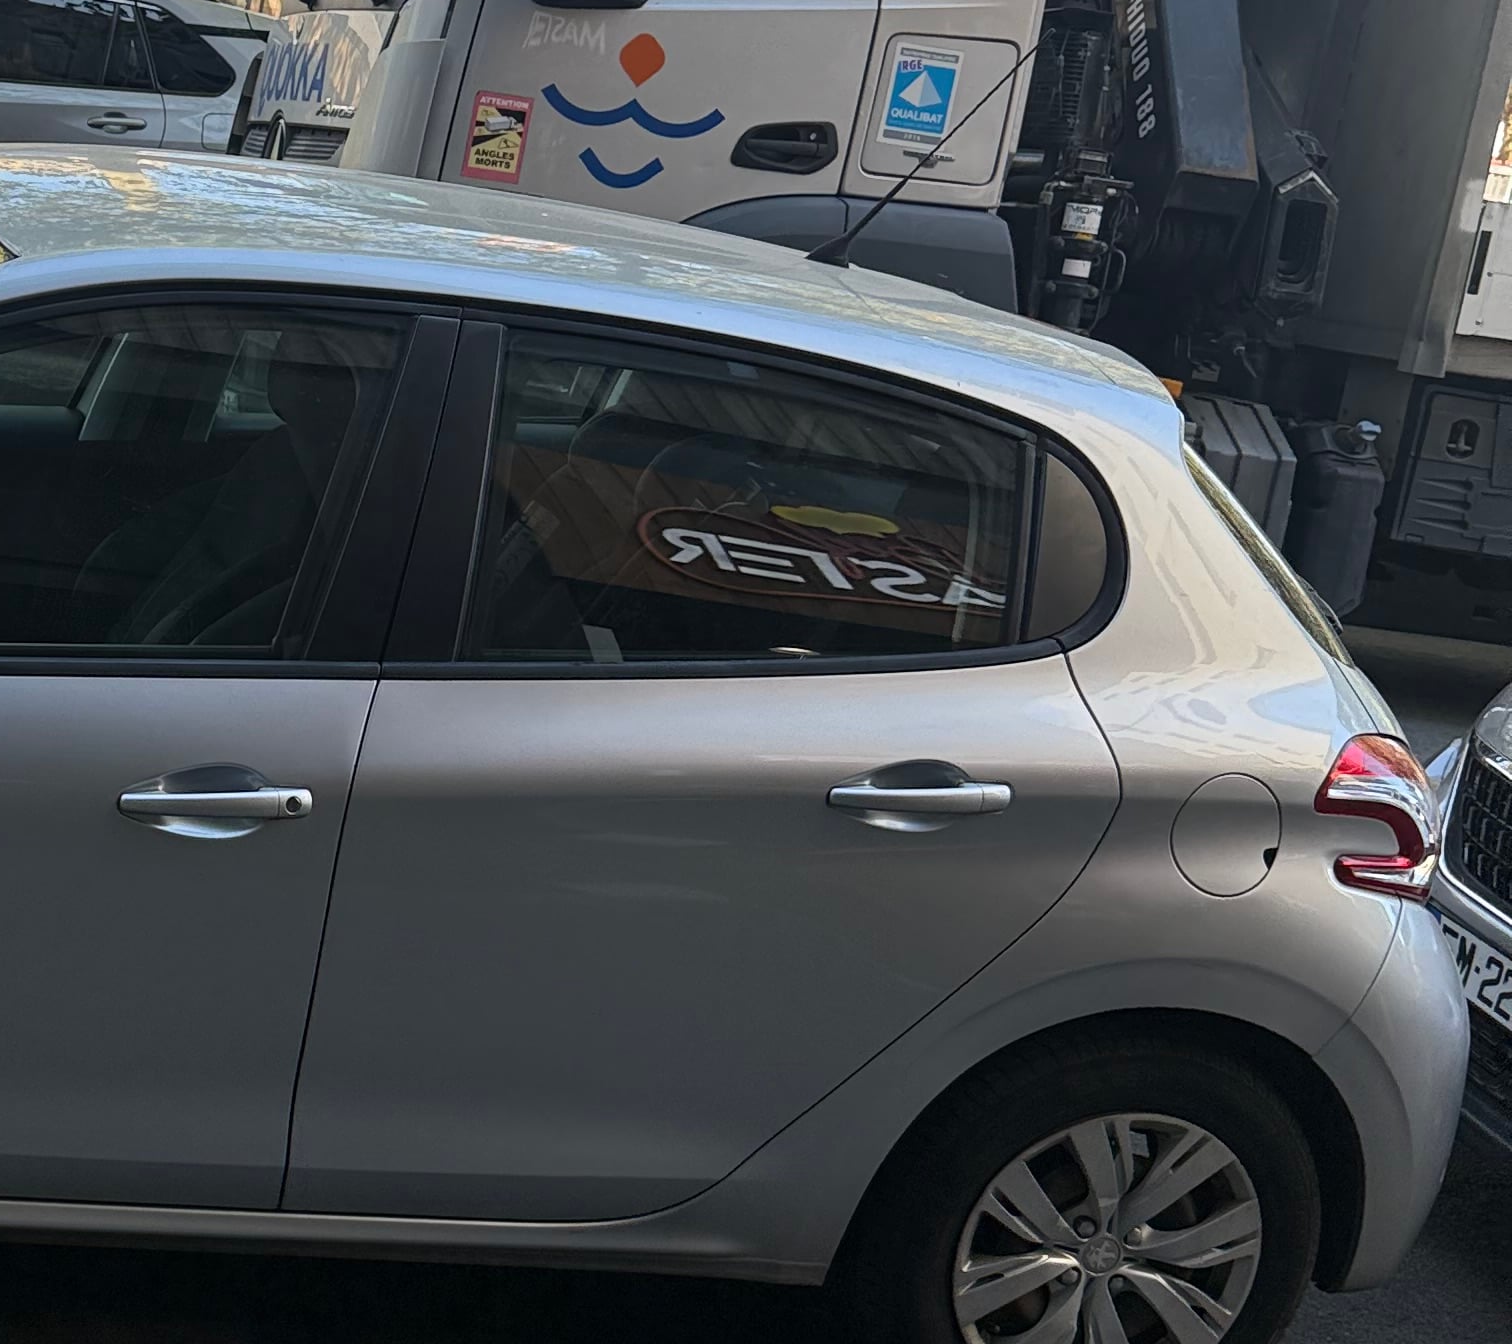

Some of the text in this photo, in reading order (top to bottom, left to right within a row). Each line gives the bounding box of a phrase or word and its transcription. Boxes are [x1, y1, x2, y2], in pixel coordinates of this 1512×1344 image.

[902, 59, 923, 71] RGE
[479, 95, 530, 109] ATTENTION
[890, 107, 944, 124] QUALIBAT
[1136, 83, 1157, 139] 188
[474, 148, 515, 161] ANGLES
[474, 157, 511, 169] MORTS
